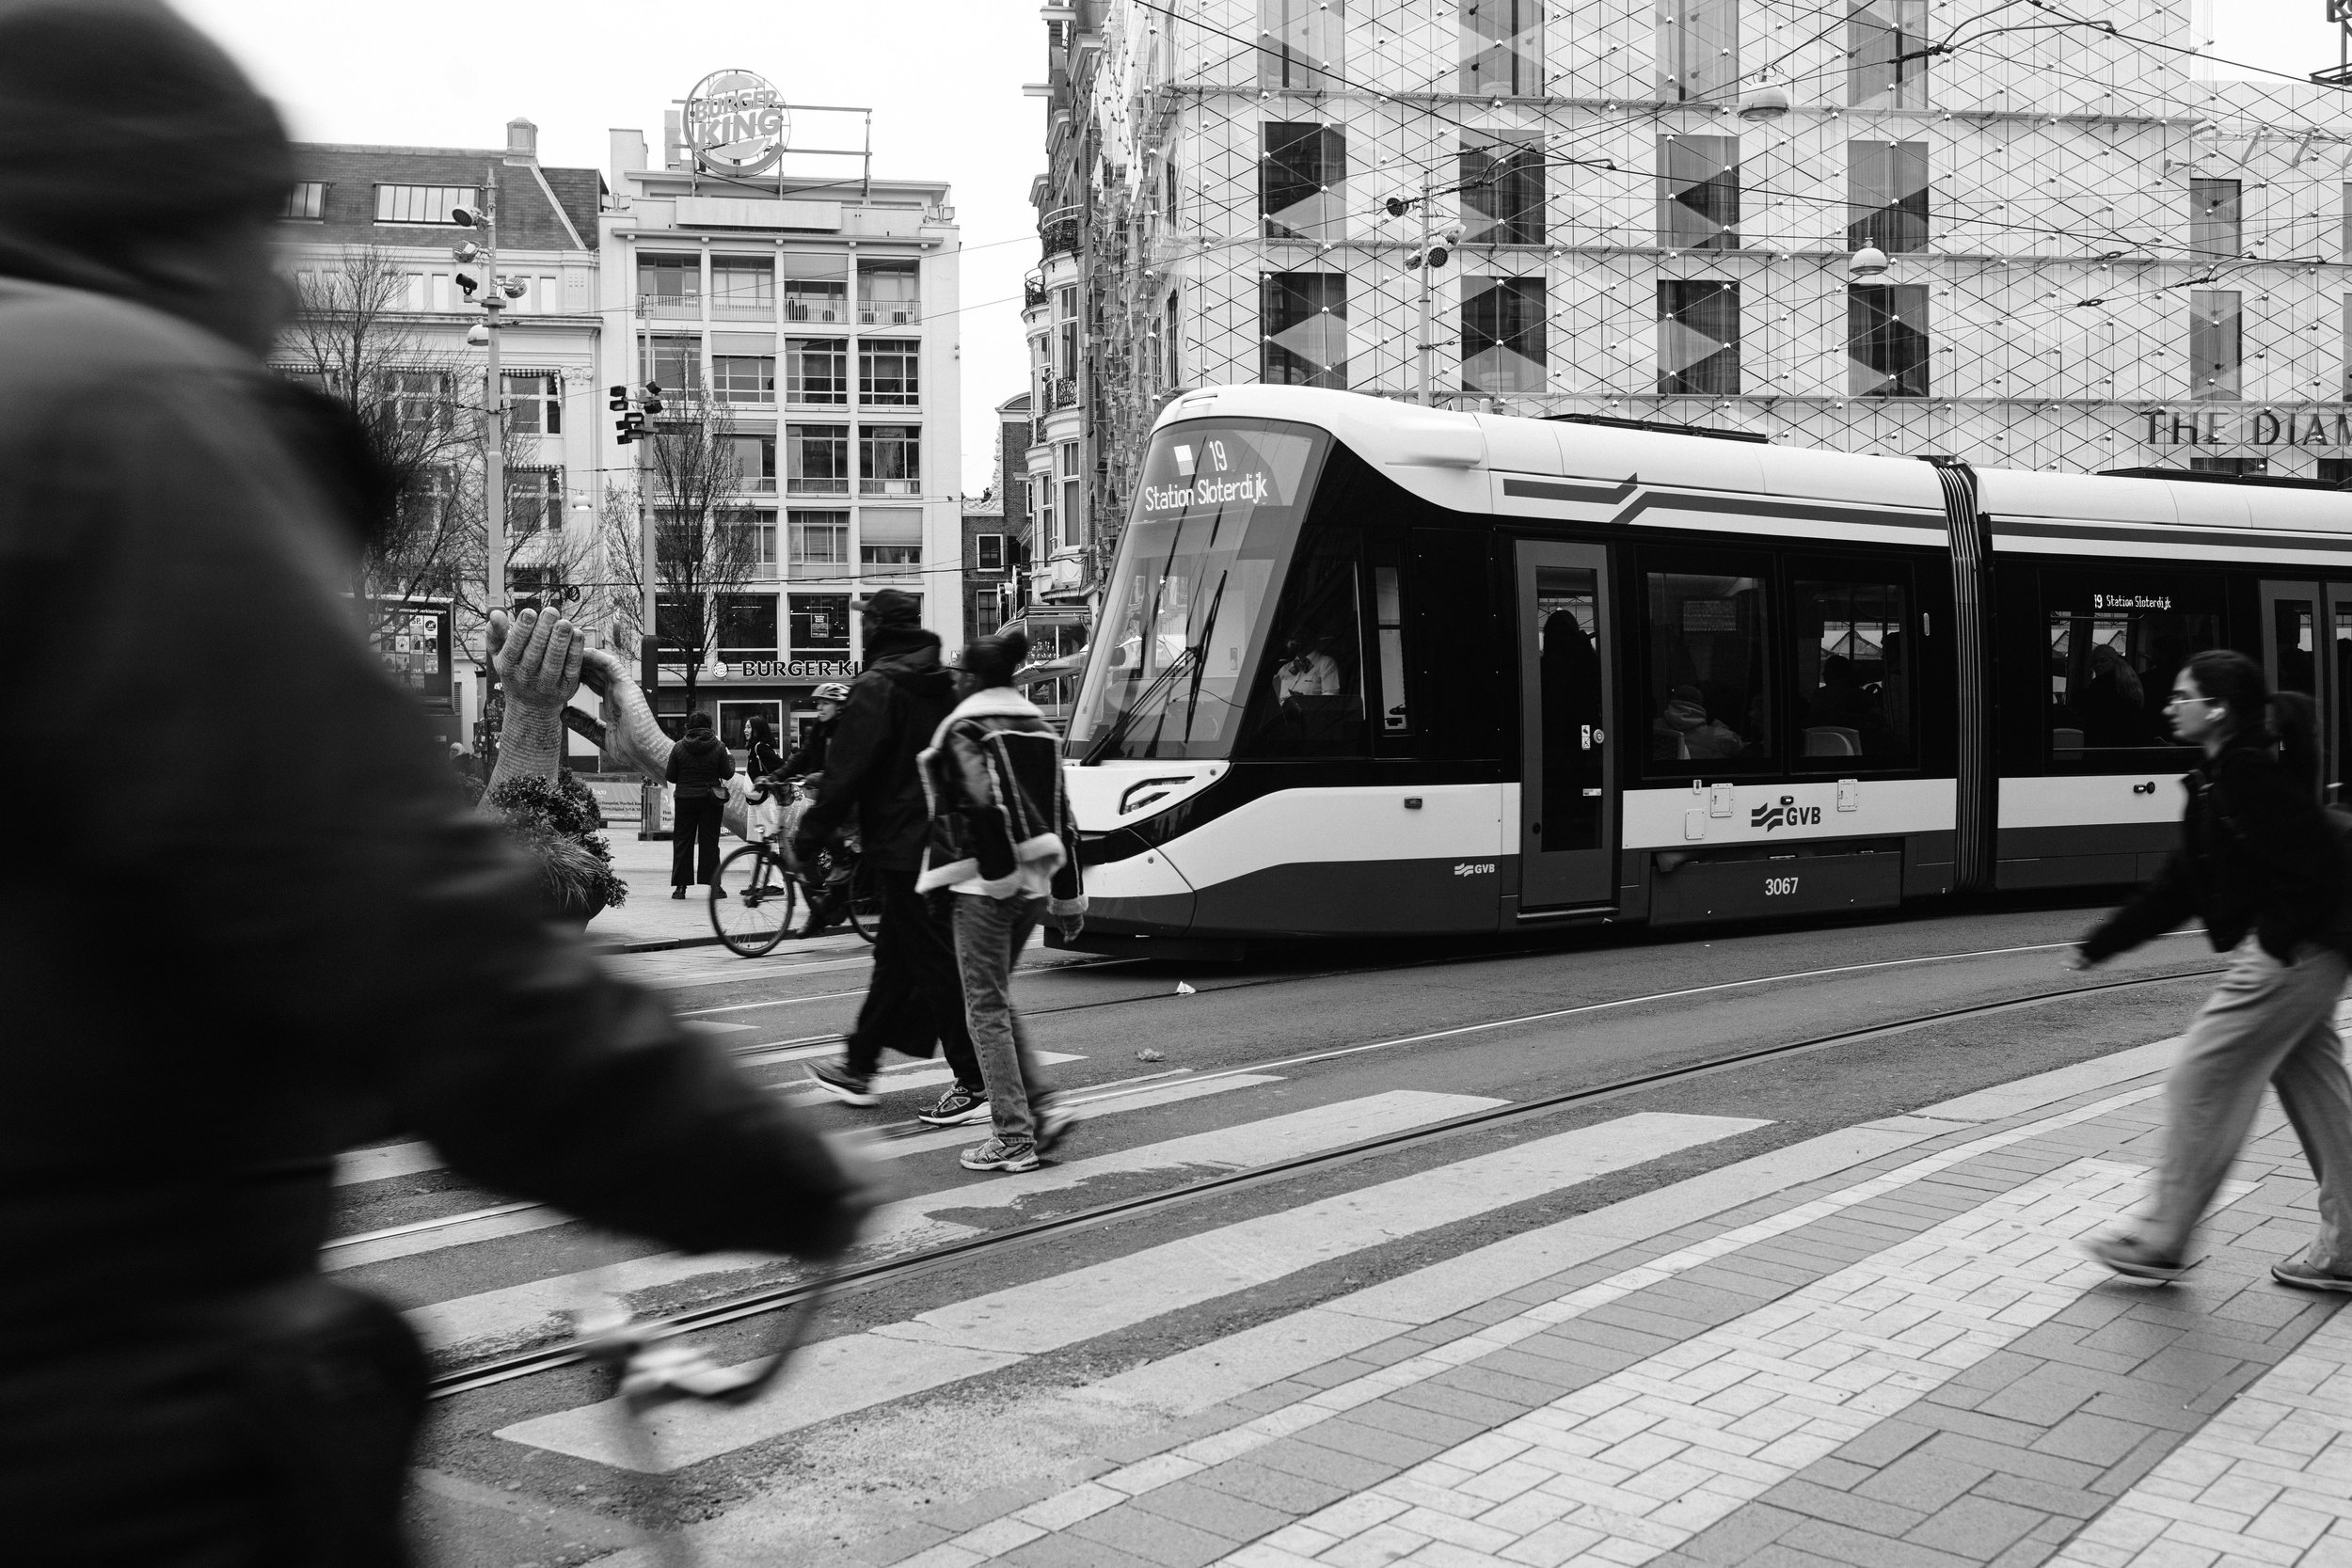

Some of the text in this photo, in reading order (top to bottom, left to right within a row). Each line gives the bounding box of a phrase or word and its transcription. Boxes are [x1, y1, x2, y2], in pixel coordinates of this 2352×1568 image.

[694, 89, 779, 122] BURGER
[695, 108, 783, 151] KING
[2140, 411, 2229, 445] THE
[1209, 440, 1228, 472] 19
[1145, 471, 1268, 512] Station Sloterdijk
[2094, 594, 2171, 610] 19 Station Sloterdijk
[741, 660, 833, 677] BURGER
[837, 660, 859, 677] KI
[1786, 807, 1821, 826] GVB
[1474, 863, 1495, 874] GVB
[1765, 877, 1799, 896] 3067
